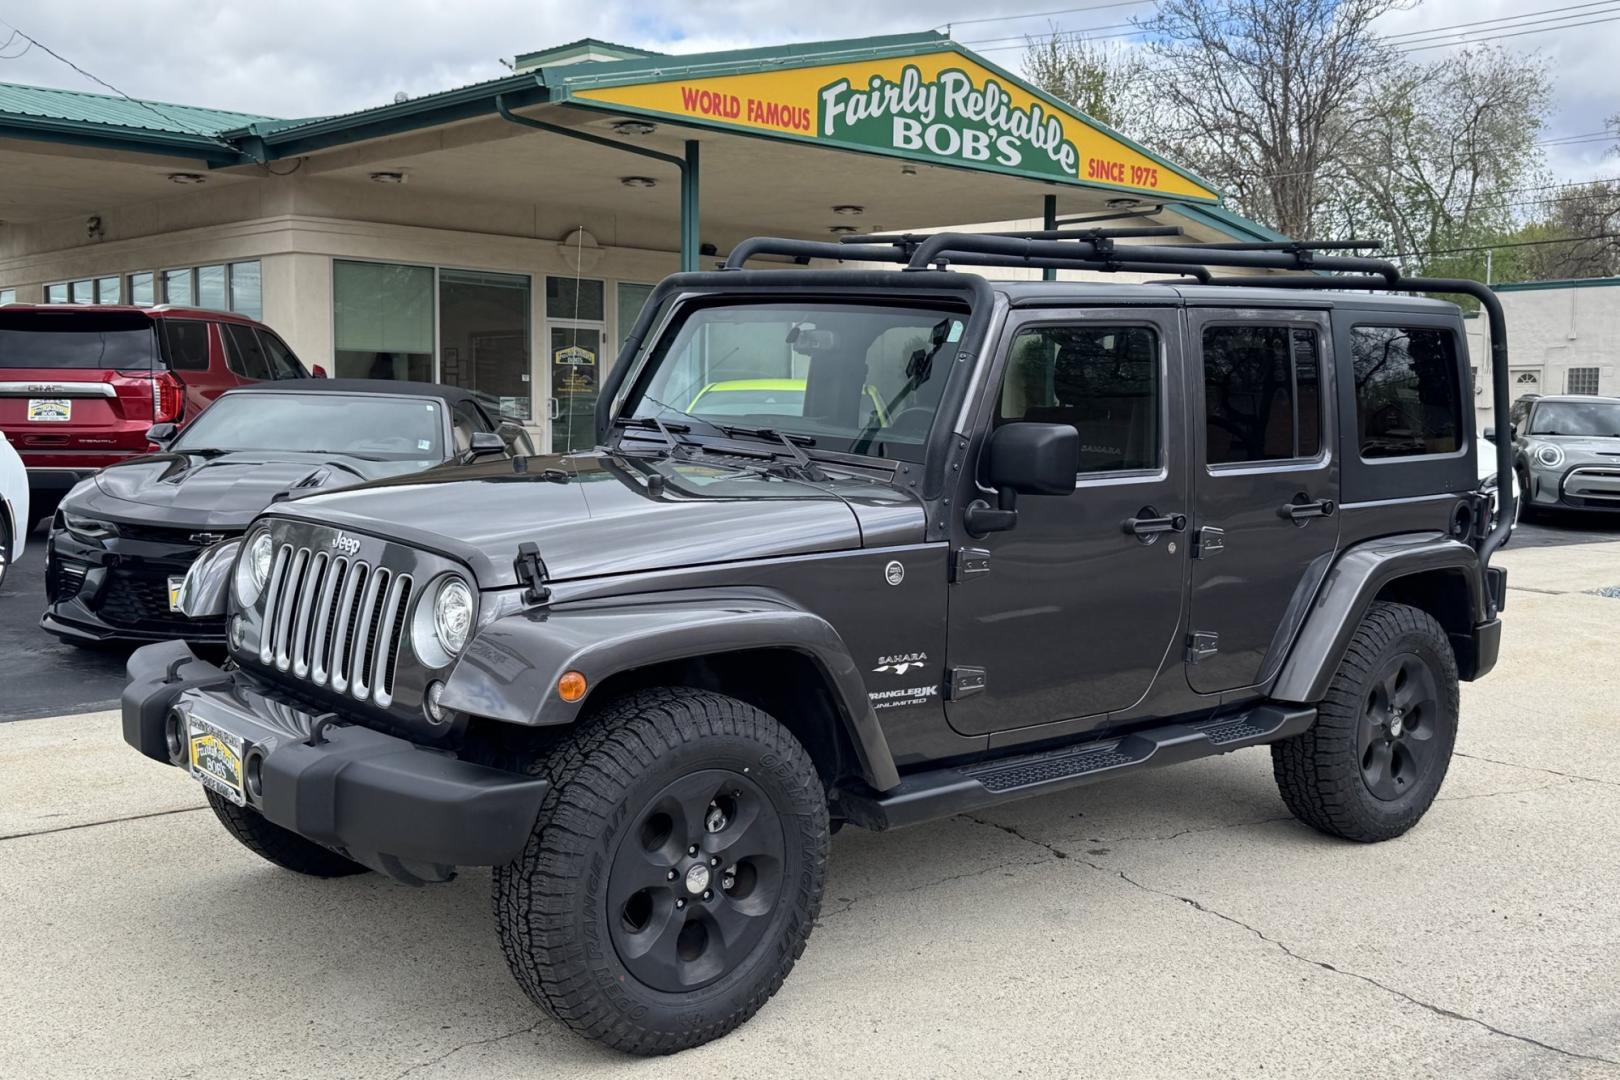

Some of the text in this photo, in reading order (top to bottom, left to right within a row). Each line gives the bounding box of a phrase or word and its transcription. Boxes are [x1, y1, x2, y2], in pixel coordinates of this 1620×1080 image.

[681, 86, 811, 131] WORLD FAMOUS
[822, 68, 1077, 174] Fairly Reliable
[893, 115, 1023, 166] BOB'S
[1088, 158, 1158, 187] SINCE 1975
[332, 530, 361, 556] Jeep
[878, 652, 928, 665] SAHARA
